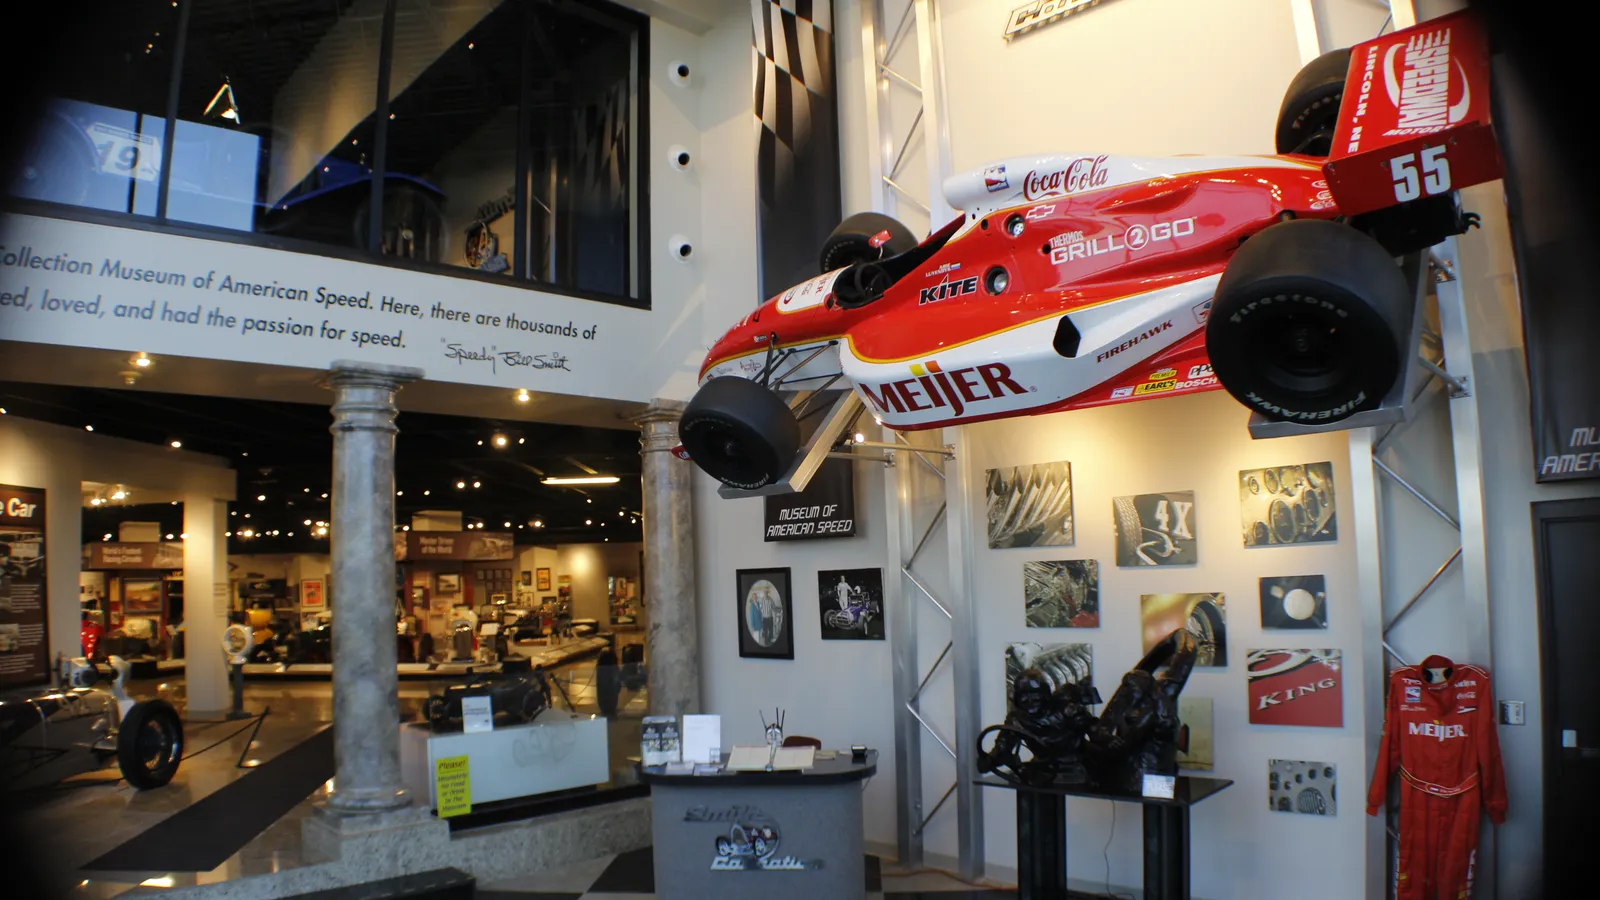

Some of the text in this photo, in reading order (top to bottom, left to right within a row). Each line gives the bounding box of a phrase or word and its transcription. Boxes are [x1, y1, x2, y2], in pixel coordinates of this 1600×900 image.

[1348, 45, 1379, 154] LINCOLN, NE
[1398, 43, 1449, 128] SPEEDWAY
[1023, 155, 1109, 202] Coca-Cola
[1390, 144, 1451, 202] 55
[1049, 230, 1085, 248] THERMOS
[99, 258, 186, 287] Museum
[192, 270, 216, 290] of
[218, 275, 308, 302] American
[314, 286, 373, 310] Speed.
[380, 295, 424, 320] Here,
[431, 302, 471, 323] there
[475, 313, 501, 327] are
[506, 312, 578, 338] thousands
[582, 324, 597, 340] of
[918, 274, 979, 305] KITE
[40, 289, 106, 319] loved,
[113, 300, 156, 320] and
[160, 301, 202, 325] had
[206, 307, 237, 328] the
[241, 317, 314, 337] passion
[319, 320, 346, 341] for
[350, 329, 406, 349] speed.
[1229, 293, 1348, 324] Firestone
[1096, 319, 1174, 364] FIREHAWK
[858, 360, 1029, 417] MEIJER
[1144, 379, 1175, 390] EARL'S
[1174, 376, 1218, 389] BOSCH
[1245, 390, 1366, 419] FIREHAWK
[8, 497, 37, 518] Car
[779, 504, 837, 521] MUSEUM OF
[766, 519, 852, 537] AMERICAN SPEED
[1257, 678, 1337, 710] KING
[1408, 720, 1465, 742] MEIJER
